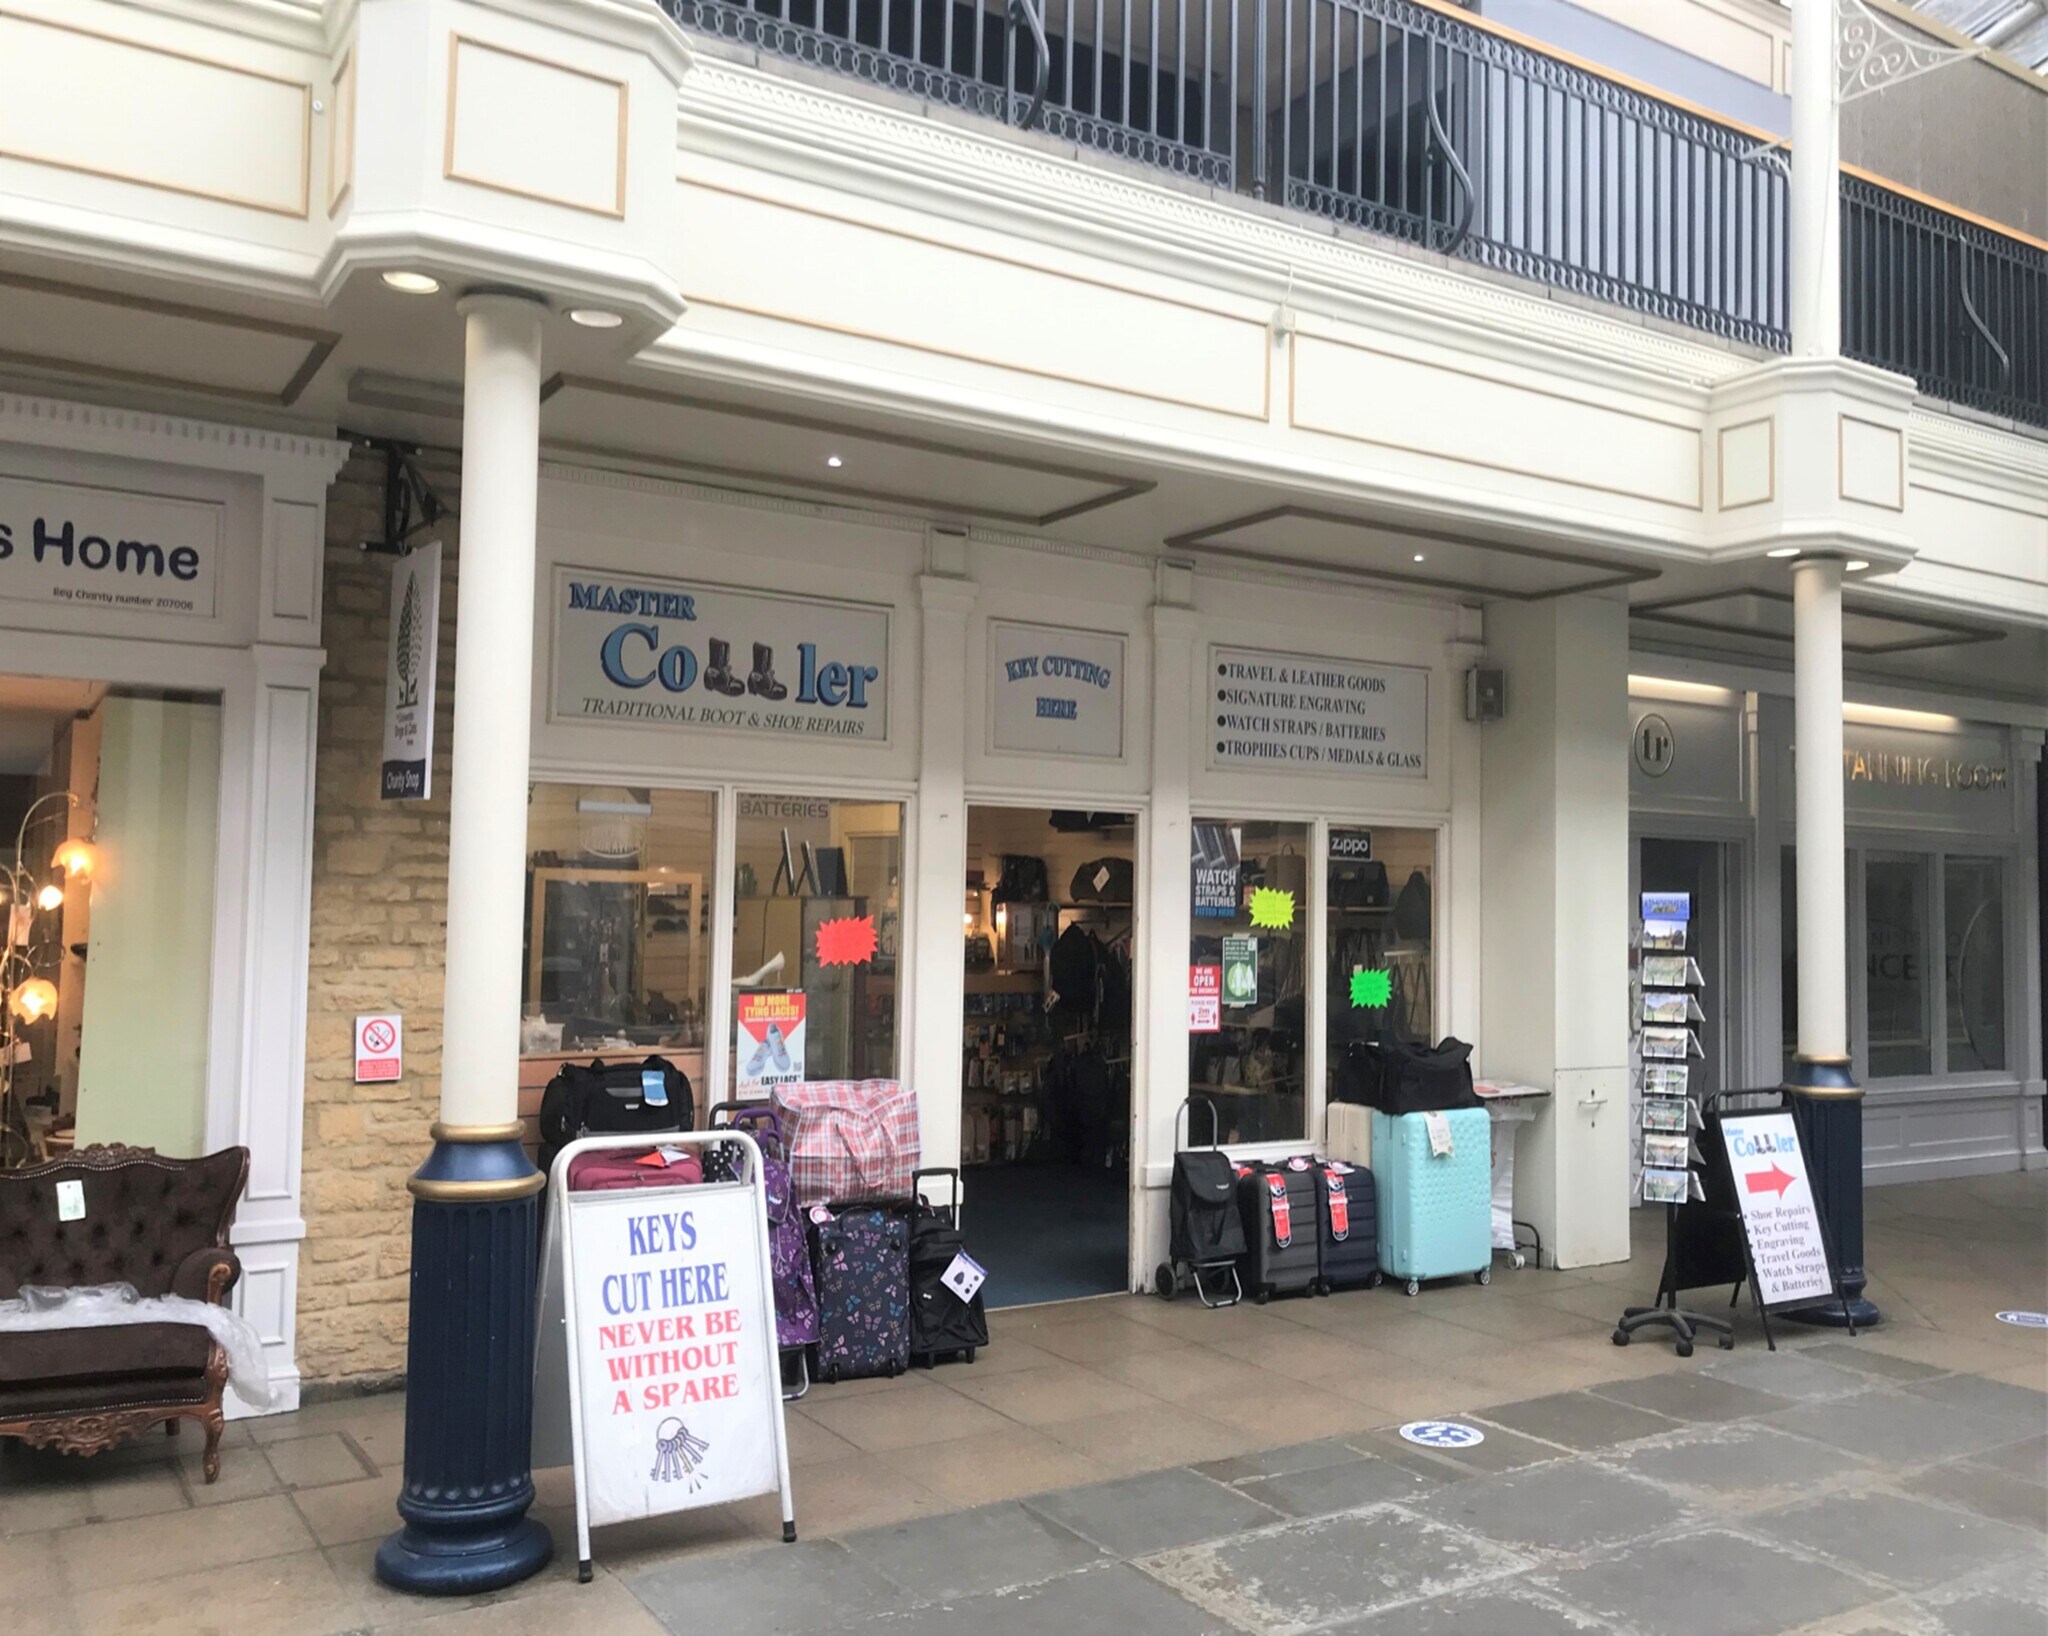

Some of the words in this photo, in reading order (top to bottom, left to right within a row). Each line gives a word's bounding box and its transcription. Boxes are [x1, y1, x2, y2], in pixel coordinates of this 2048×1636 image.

[32, 518, 200, 581] Home
[53, 587, 73, 600] Reg
[75, 588, 113, 603] Charity
[115, 594, 154, 606] number
[568, 582, 697, 620] MASTER
[1005, 656, 1039, 683] KEY
[1042, 655, 1112, 689] CUTTING
[1228, 663, 1277, 683] TRAVEL
[1279, 669, 1288, 683] &
[1292, 669, 1345, 689] LEATHER
[1348, 674, 1386, 693] GOODS
[1036, 696, 1078, 720] HERE
[1226, 688, 1296, 709] SIGNATURE
[1300, 695, 1366, 716] ENGRAVING
[582, 697, 696, 722] TRADITIONAL
[700, 708, 746, 726] BOOT
[748, 712, 760, 726] &
[763, 713, 803, 730] SHOE
[806, 717, 865, 735] REPAIRS
[1227, 714, 1270, 732] WATCH
[1273, 718, 1317, 737] STRAPS
[1325, 721, 1386, 742] BATTERIES
[1226, 739, 1287, 759] TROPHIES
[1289, 744, 1319, 762] CUPS
[1327, 748, 1374, 765] MEDALS
[1376, 752, 1385, 766] &
[1387, 752, 1422, 769] GLASS
[740, 800, 829, 819] BATTERIES
[1195, 868, 1237, 886] WATCH
[1195, 884, 1227, 897] STRAPS
[1229, 885, 1236, 897] &
[1195, 896, 1236, 908] BATTERIES
[1194, 975, 1215, 987] OPEN
[754, 994, 765, 1006] NO
[761, 1076, 778, 1086] EASY
[1750, 1210, 1773, 1221] Shoe
[1775, 1205, 1811, 1218] Repairs
[627, 1210, 698, 1256] KEYS
[1754, 1224, 1772, 1236] Key
[1774, 1220, 1810, 1233] Cutting
[1757, 1235, 1805, 1250] Engraving
[1761, 1250, 1790, 1264] Travel
[1791, 1246, 1821, 1260] Goods
[1763, 1265, 1793, 1279] Watch
[1795, 1262, 1826, 1274] Straps
[602, 1271, 653, 1316] CUT
[660, 1262, 730, 1310] HERE
[1771, 1282, 1780, 1293] &
[1782, 1277, 1824, 1292] Batteries
[598, 1315, 696, 1351] NEVER
[705, 1309, 743, 1336] BE
[607, 1341, 738, 1382] WITHOUT
[612, 1390, 633, 1415] A
[643, 1373, 741, 1411] SPARE
